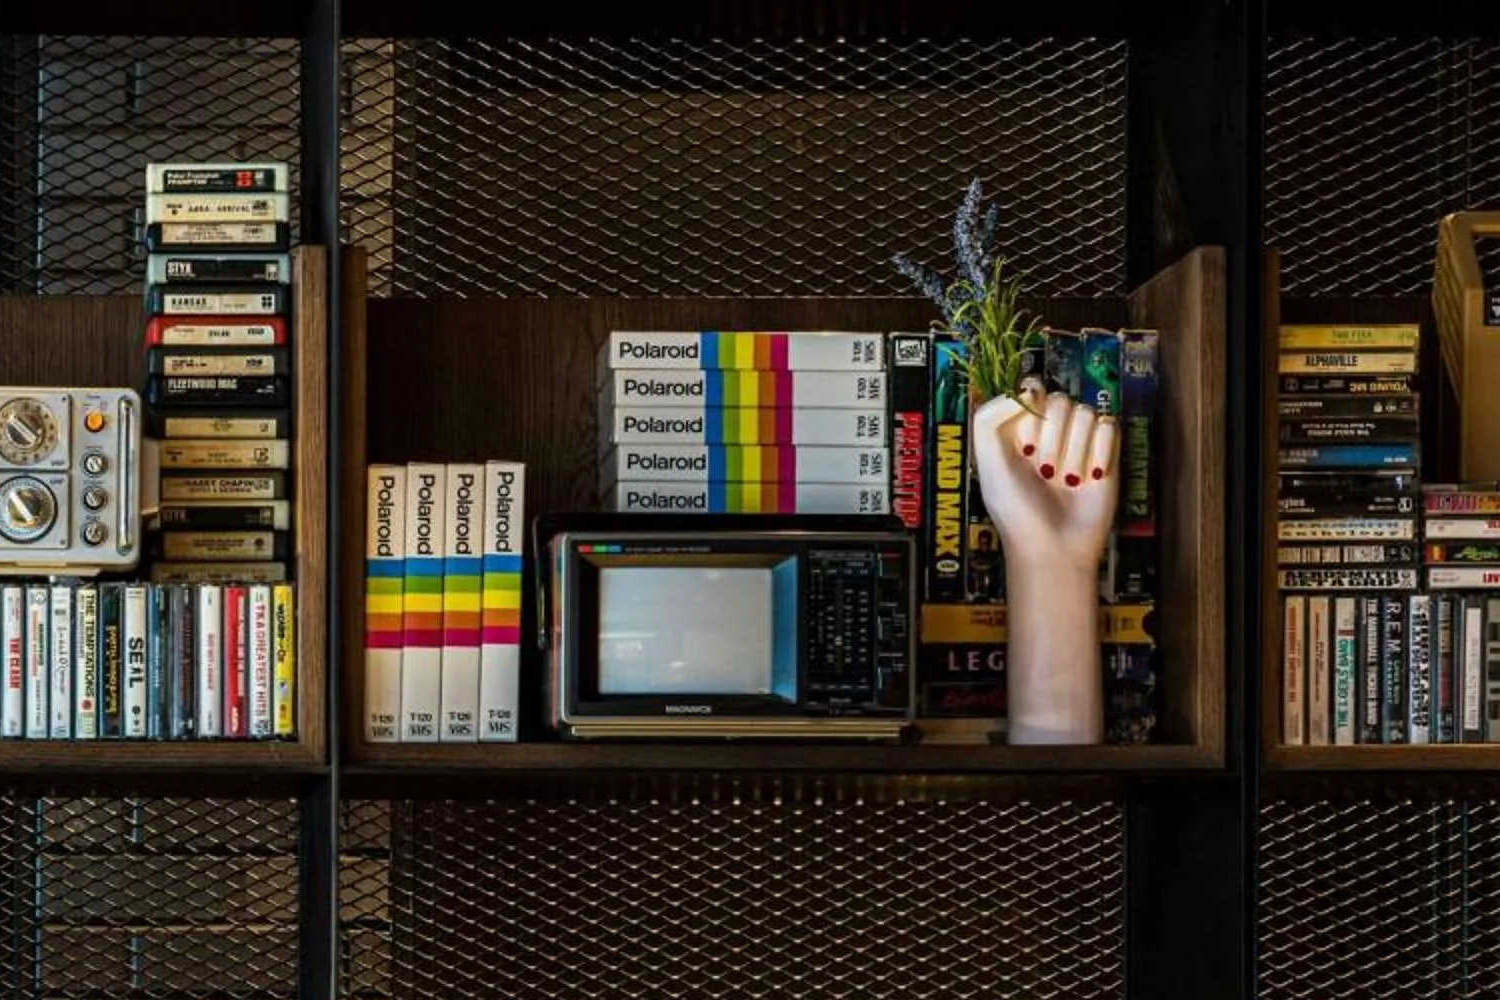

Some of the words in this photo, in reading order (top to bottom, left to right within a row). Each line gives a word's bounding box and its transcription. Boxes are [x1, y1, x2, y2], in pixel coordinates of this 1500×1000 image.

[619, 342, 699, 359] Polaroid
[1306, 356, 1357, 367] ALPHAVILLE
[624, 380, 702, 396] Polaroid
[624, 417, 702, 434] Polaroid
[627, 454, 706, 471] Polaroid
[936, 424, 961, 490] MAD
[378, 475, 396, 557] Polaroid
[417, 473, 435, 555] Polaroid
[456, 473, 474, 555] Polaroid
[496, 471, 515, 552] Polaroid
[627, 492, 706, 509] Polaroid
[936, 494, 961, 556] MAX
[85, 595, 94, 616] THE
[85, 621, 94, 698] TEMPTATIONS
[256, 631, 266, 688] GREATEST
